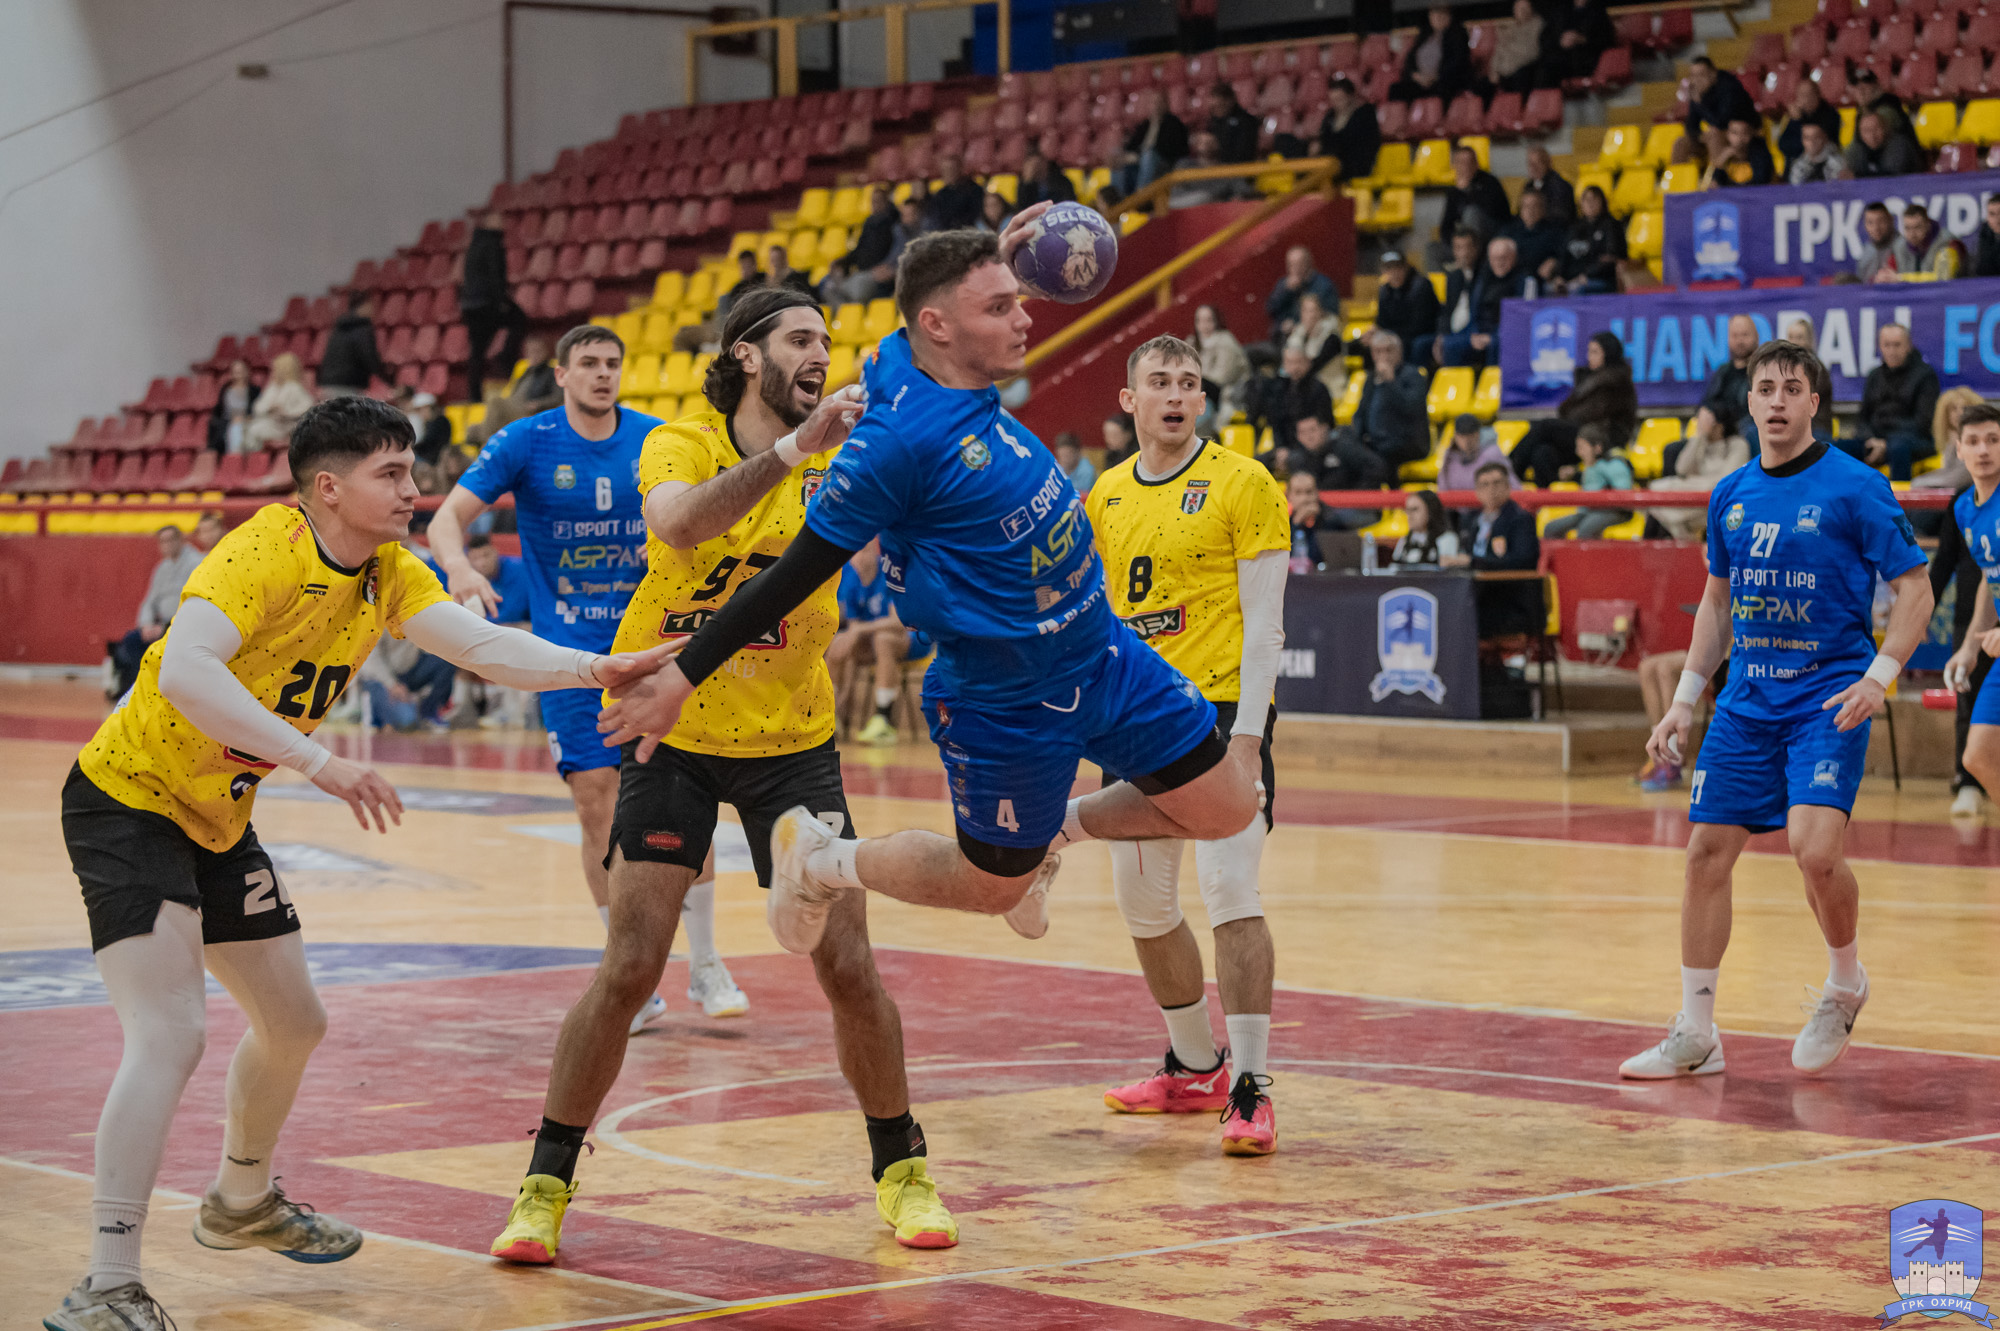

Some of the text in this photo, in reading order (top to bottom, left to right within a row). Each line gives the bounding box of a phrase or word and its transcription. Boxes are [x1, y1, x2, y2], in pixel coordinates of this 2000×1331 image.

[1045, 208, 1105, 229] SELECT
[1773, 200, 1864, 264] ГРК
[595, 476, 613, 511] 6
[1749, 522, 1781, 559] 27
[1127, 555, 1153, 603] 8
[1123, 613, 1176, 636] NEX
[274, 659, 351, 720] 20
[996, 799, 1020, 833] 4
